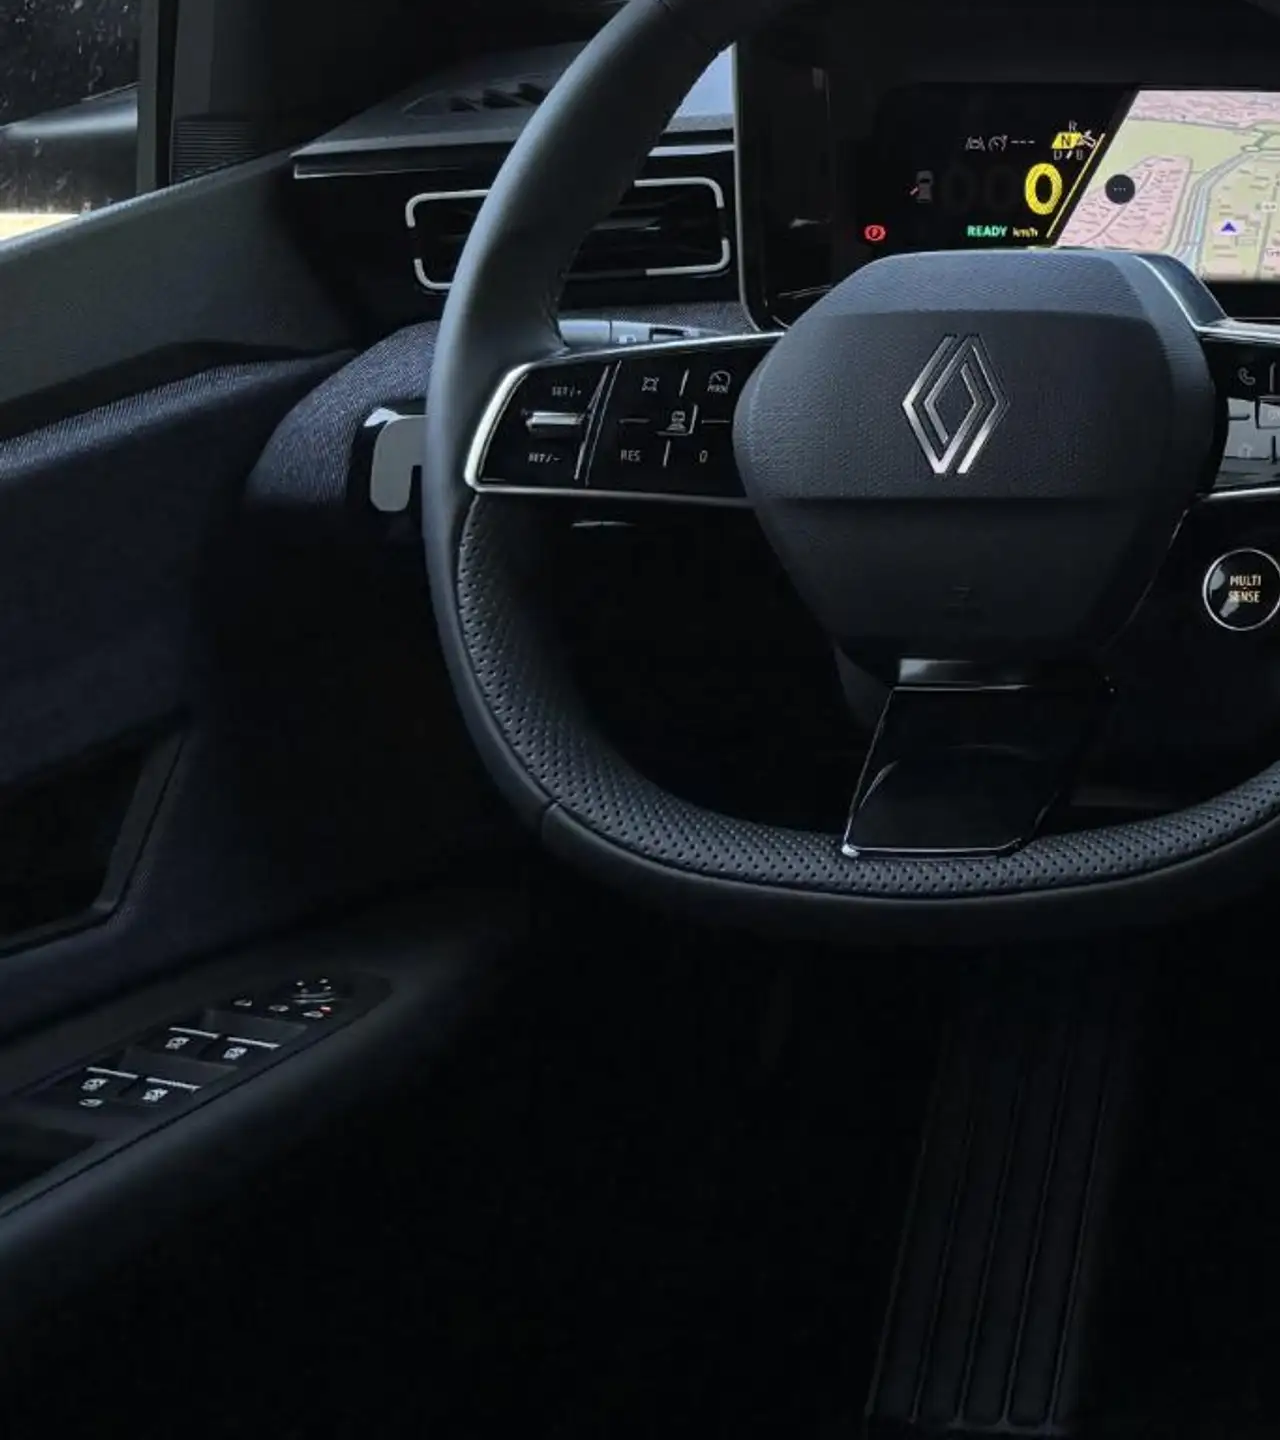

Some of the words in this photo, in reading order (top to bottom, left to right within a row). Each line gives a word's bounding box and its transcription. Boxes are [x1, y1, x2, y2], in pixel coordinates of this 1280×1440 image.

[1061, 134, 1071, 147] N
[966, 225, 1008, 238] READY
[1012, 226, 1039, 238] km/h
[1229, 574, 1262, 587] MULTI
[1228, 590, 1261, 603] SENSE
